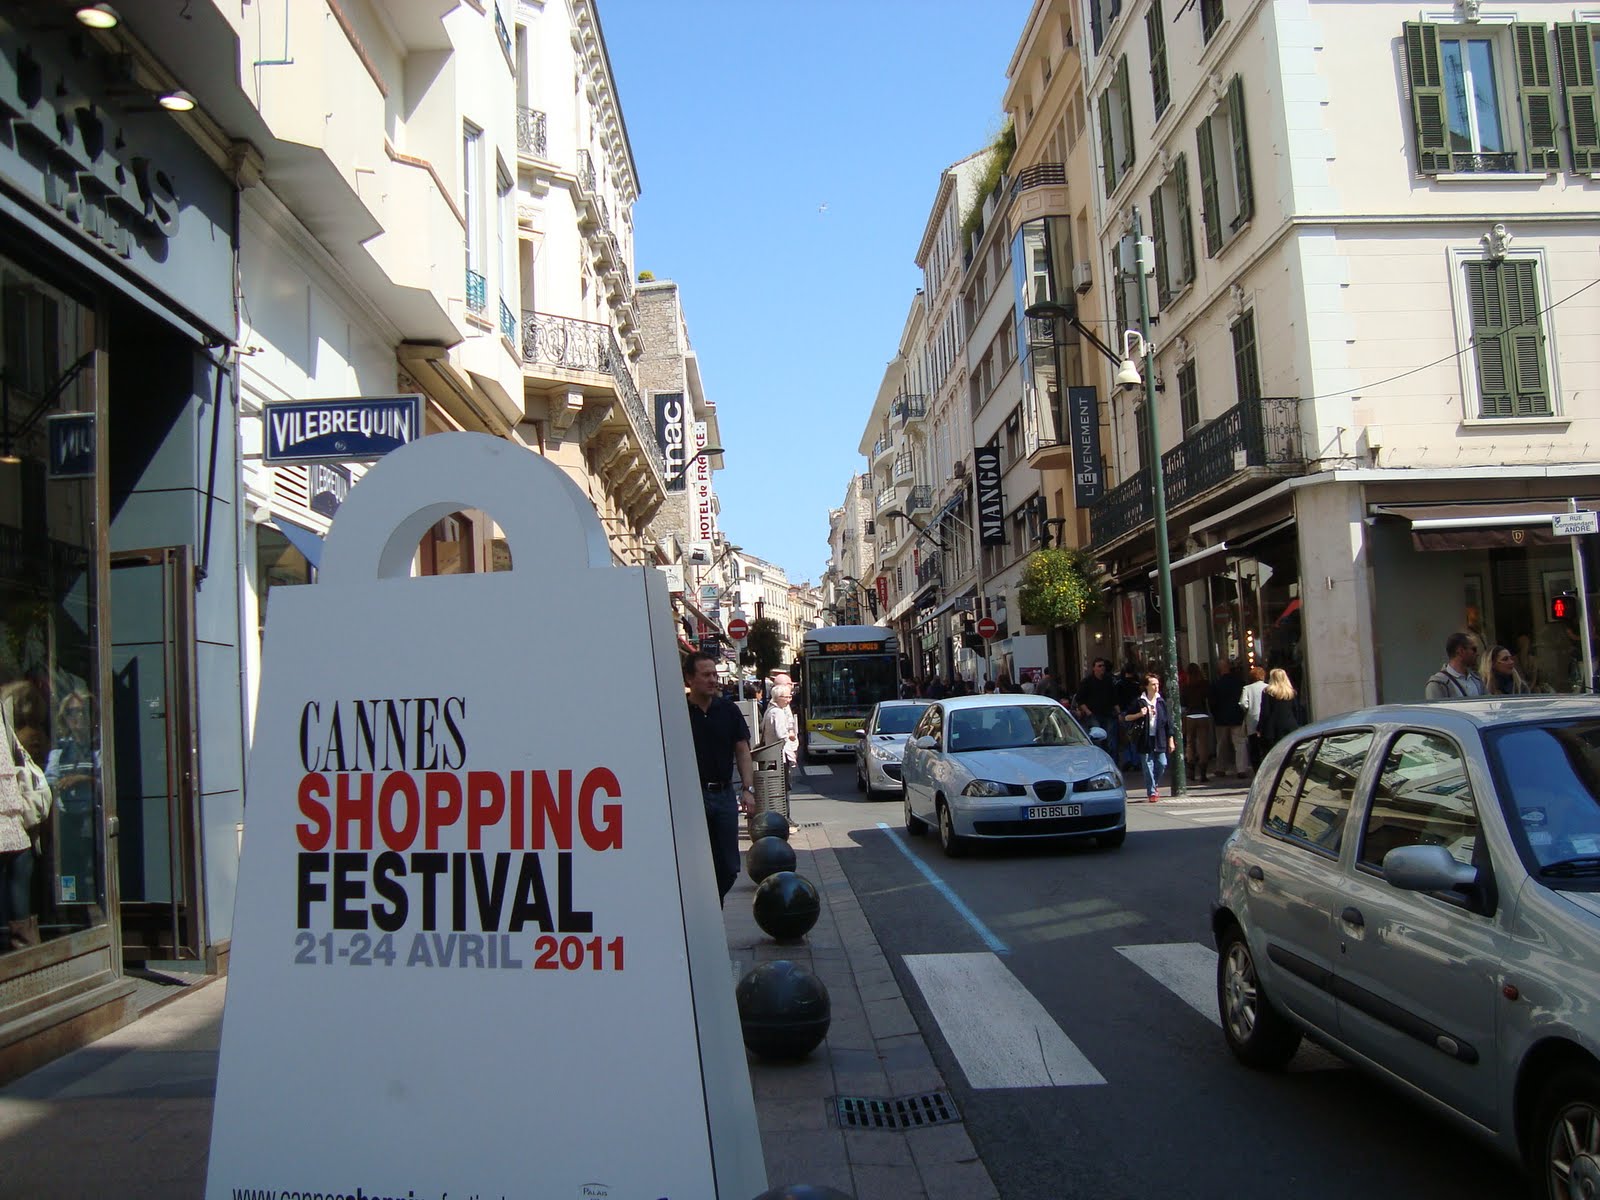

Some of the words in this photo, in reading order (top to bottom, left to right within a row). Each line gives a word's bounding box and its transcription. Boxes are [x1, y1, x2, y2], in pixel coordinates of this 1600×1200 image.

[272, 407, 410, 452] VILEBREQUIN
[664, 401, 683, 482] fnac
[698, 485, 707, 497] de
[699, 500, 711, 540] HOTEL
[977, 454, 1002, 538] MANGO
[299, 697, 467, 773] CANNES
[296, 766, 623, 852] SHOPPING
[1029, 807, 1047, 818] 816
[1049, 806, 1066, 817] BSL
[1068, 804, 1080, 816] 06
[297, 851, 593, 933] FESTIVAL
[294, 932, 397, 966] 21-24
[406, 933, 523, 969] AVRIL
[534, 935, 624, 971] 2011
